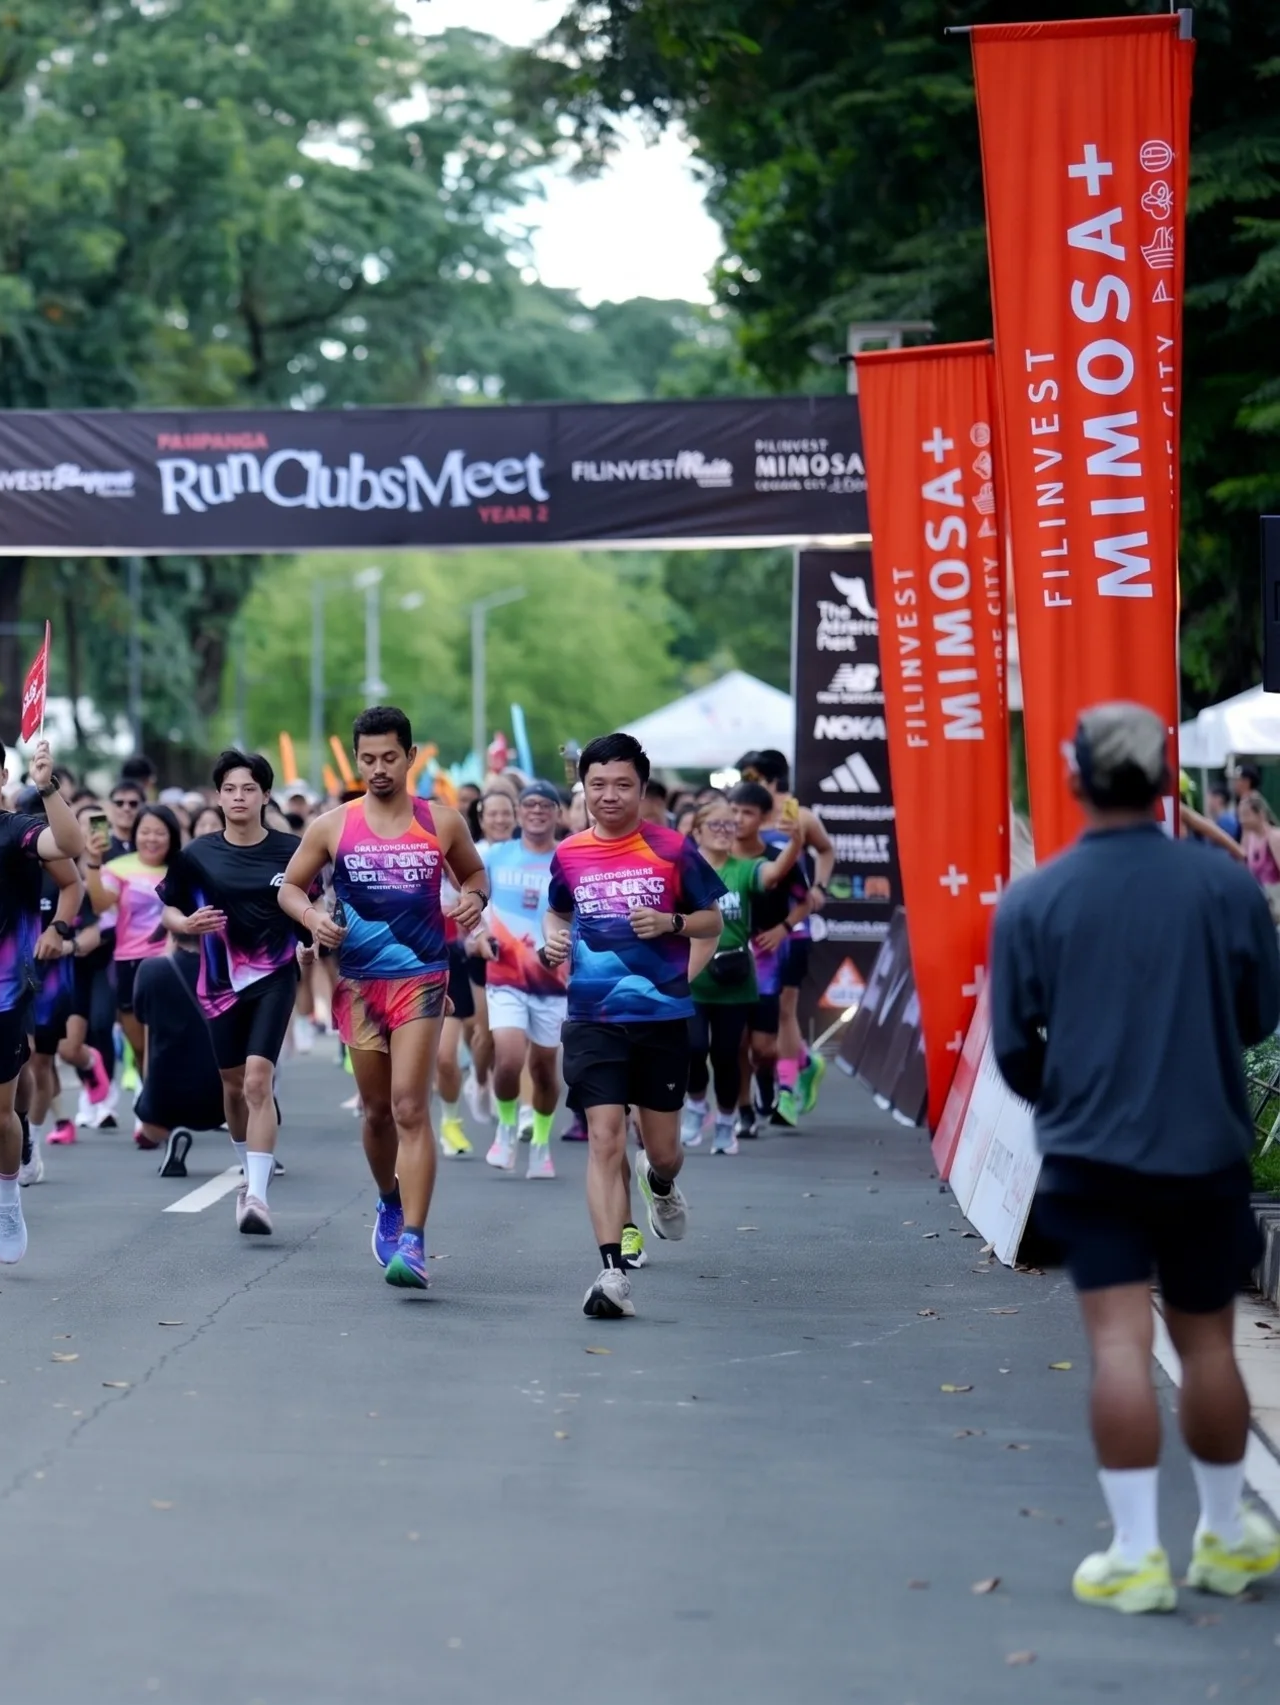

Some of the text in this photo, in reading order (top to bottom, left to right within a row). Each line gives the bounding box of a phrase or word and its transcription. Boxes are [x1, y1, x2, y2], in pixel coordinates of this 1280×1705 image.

[157, 432, 268, 450] PAMPANGA
[1026, 348, 1072, 607] FILINVEST
[478, 505, 549, 523] YEAR 2
[983, 557, 1001, 616] CITY
[892, 567, 928, 748] FILINVEST
